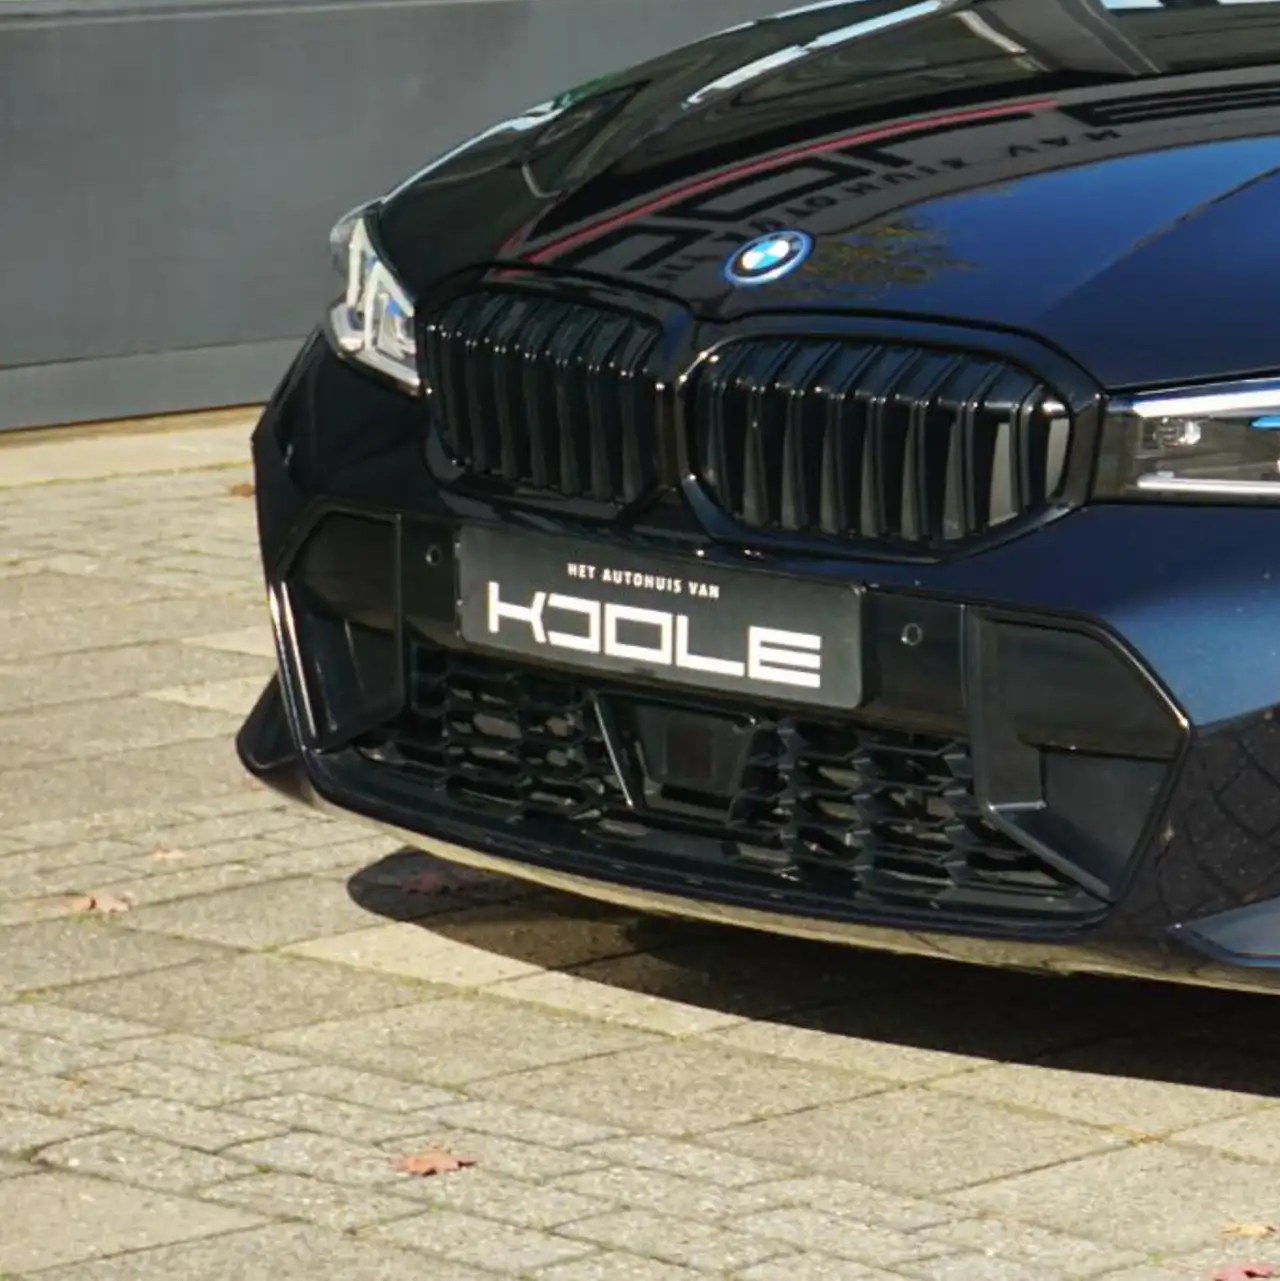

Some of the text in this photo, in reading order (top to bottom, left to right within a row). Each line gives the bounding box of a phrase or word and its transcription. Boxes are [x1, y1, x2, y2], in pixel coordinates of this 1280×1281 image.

[567, 562, 720, 599] HET AUTOHUIS VAN
[487, 580, 822, 689] KOOLE
